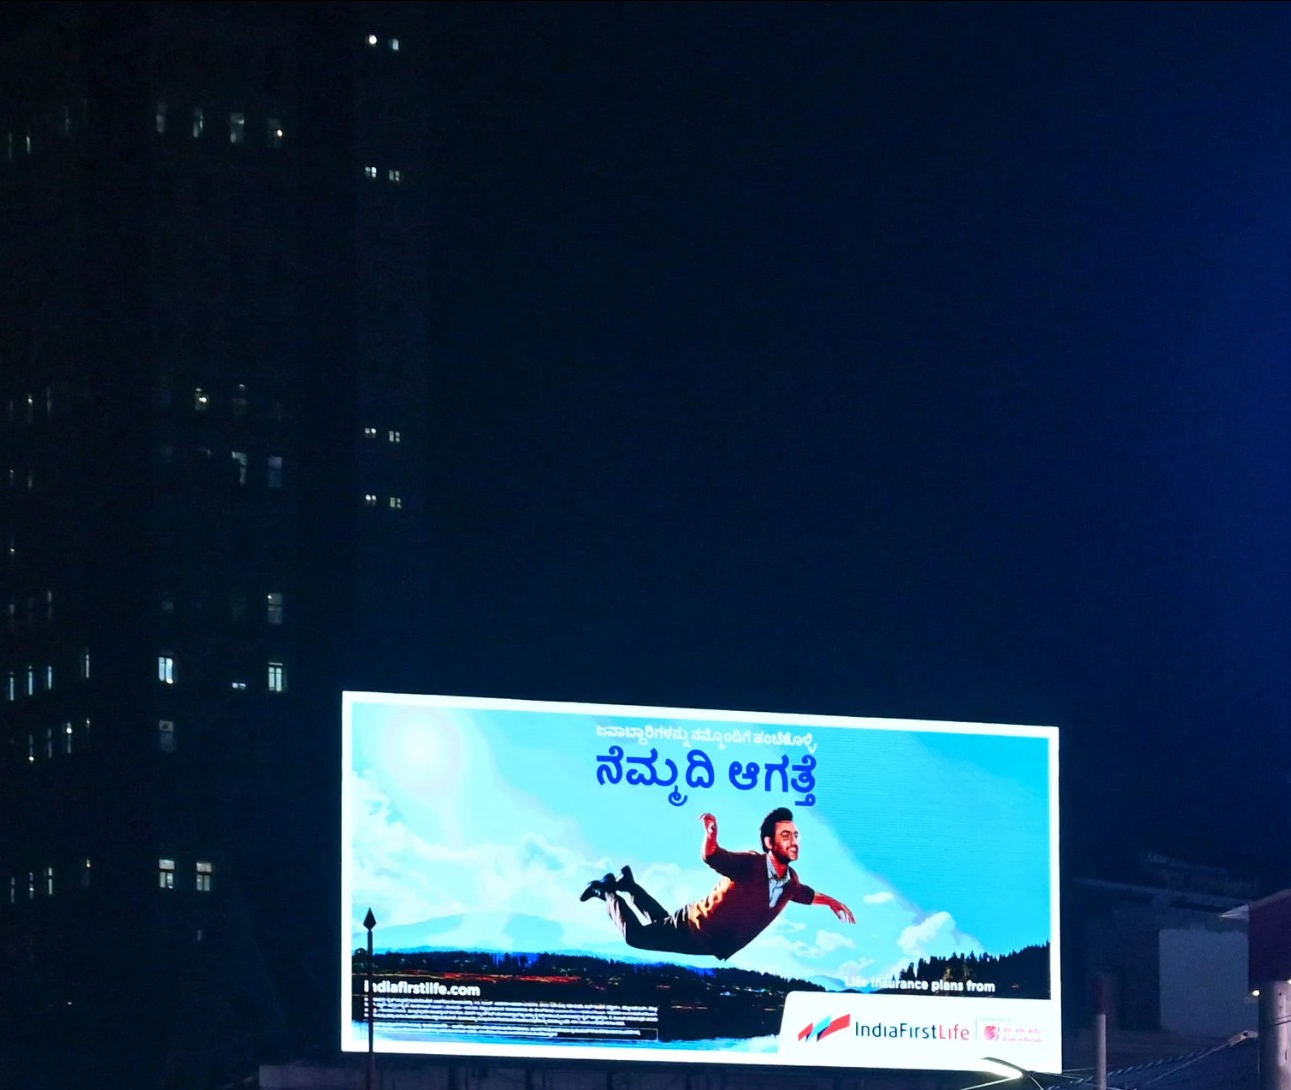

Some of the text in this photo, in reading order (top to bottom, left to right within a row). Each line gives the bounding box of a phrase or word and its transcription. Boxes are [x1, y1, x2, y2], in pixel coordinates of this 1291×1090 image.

[595, 745, 818, 807] ನೆಮ್ಮದಿ ಆಗತ್ತೆ
[845, 976, 868, 988] Life
[931, 979, 965, 993] plans
[966, 979, 996, 993] from
[855, 1021, 970, 1041] IndiaFirstLife
